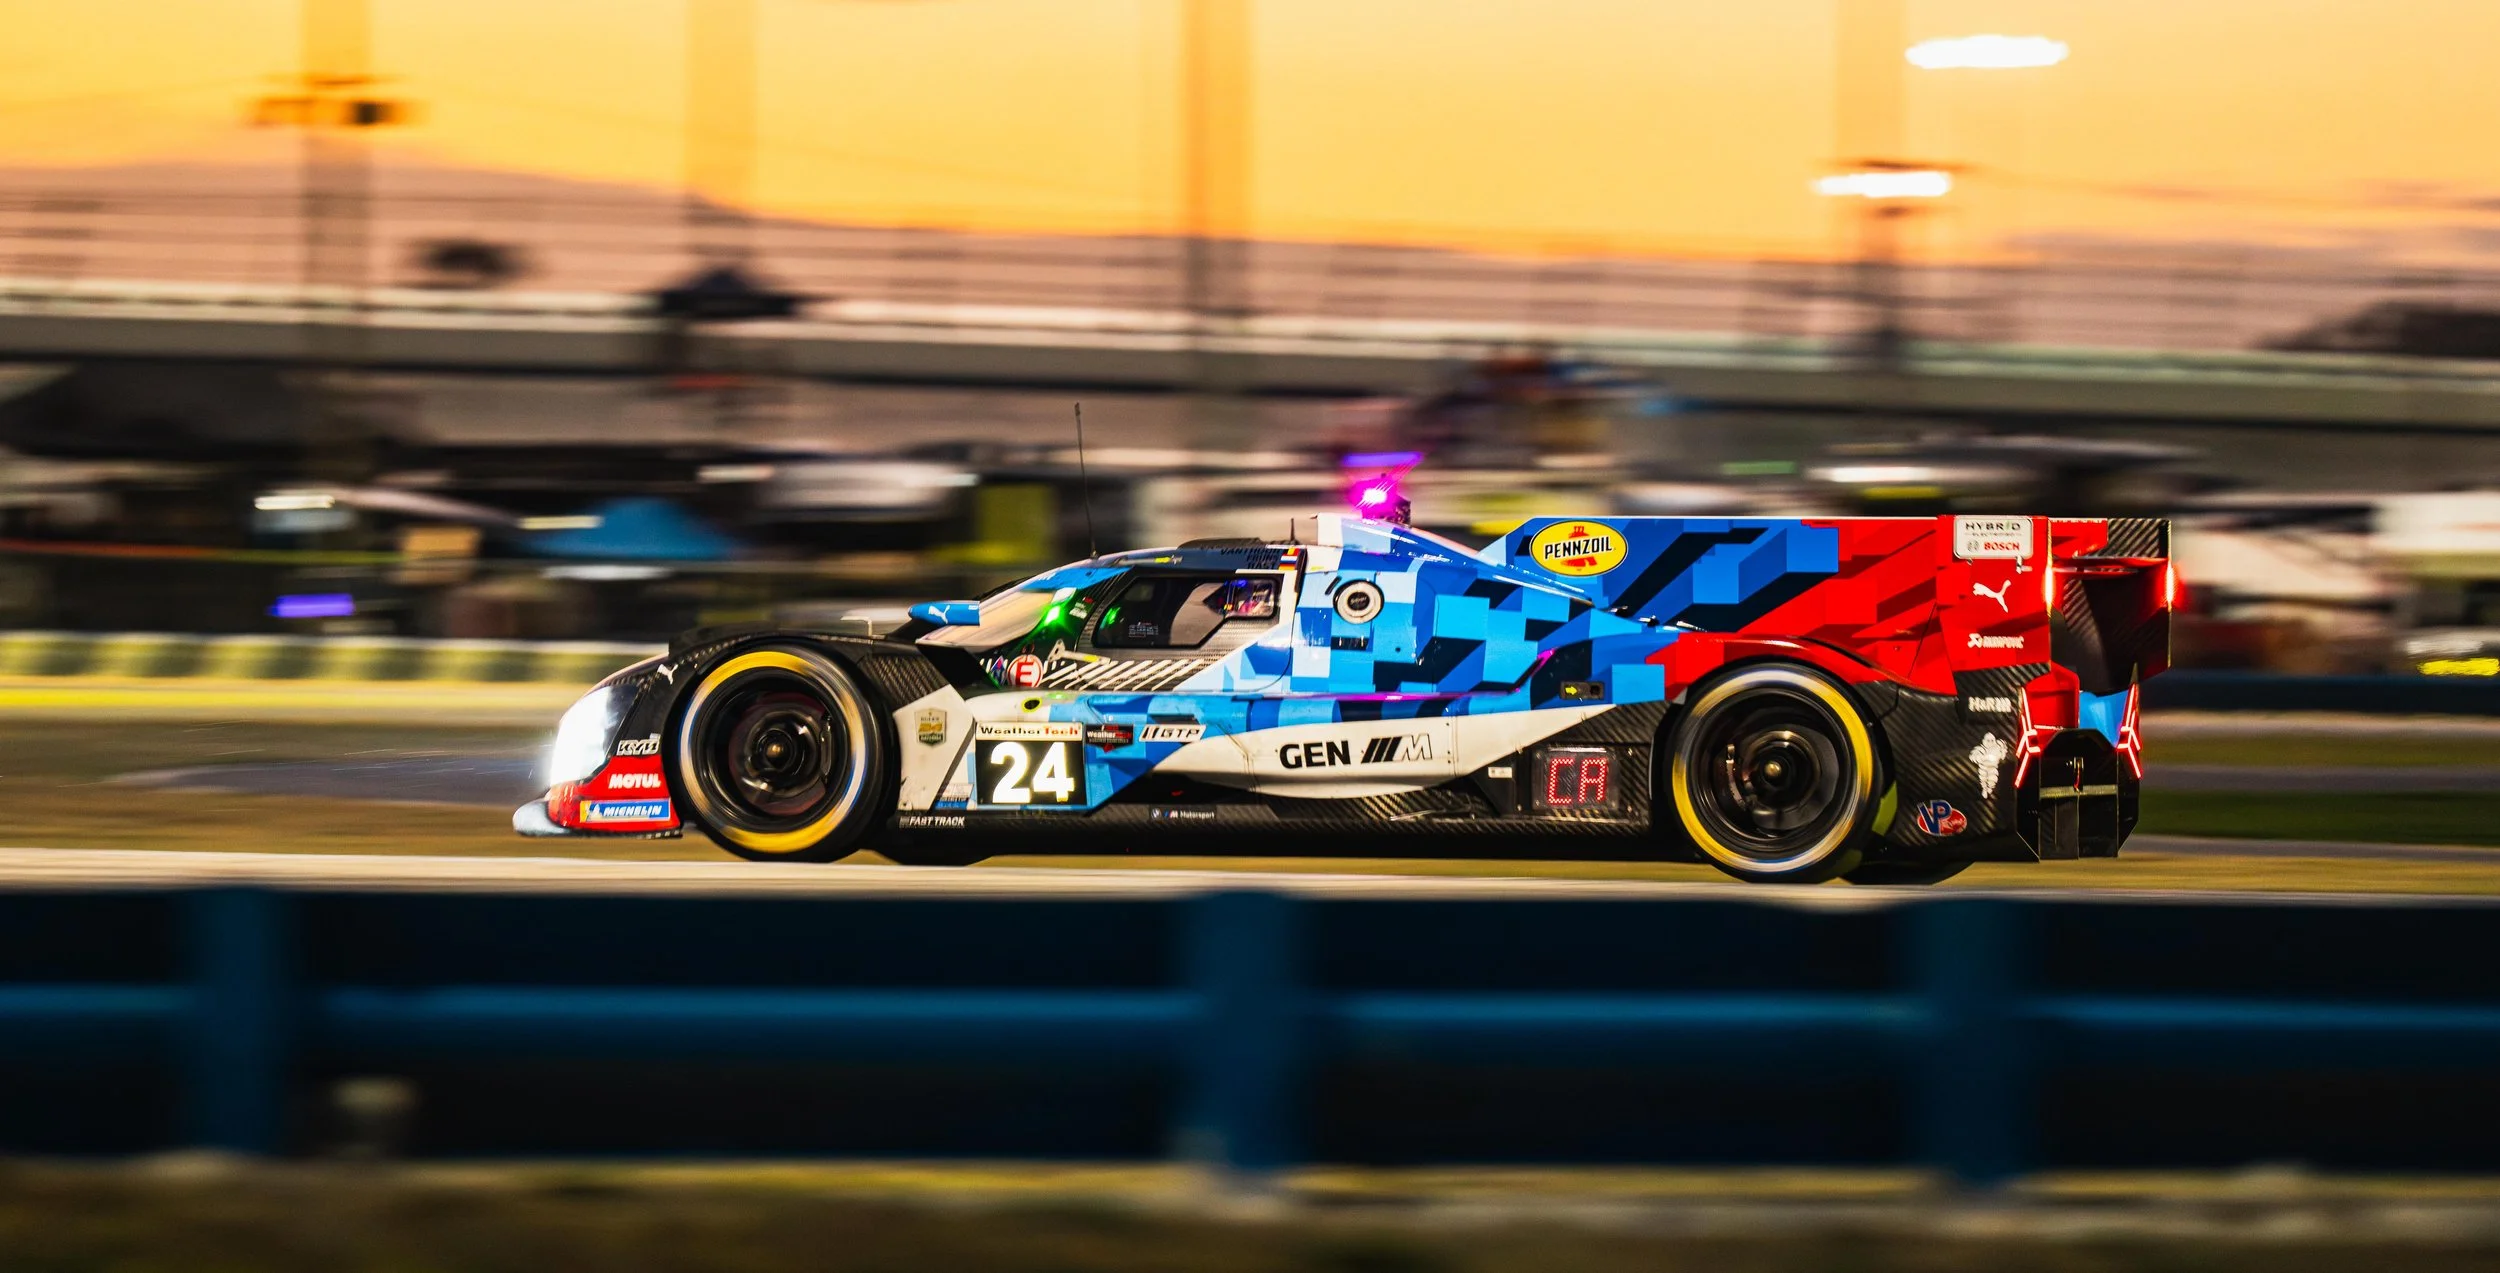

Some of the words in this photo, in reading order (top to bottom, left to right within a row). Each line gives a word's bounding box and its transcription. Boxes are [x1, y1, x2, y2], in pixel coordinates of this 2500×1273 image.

[1965, 521, 2021, 531] HYBRID
[1544, 536, 1612, 560] PENNZOIL
[1983, 541, 2020, 551] BOSCH
[1015, 661, 1034, 688] E
[980, 726, 1079, 737] WeatherTech
[1160, 728, 1200, 739] GTP
[1279, 739, 1352, 770] GEN
[989, 741, 1076, 804] 24
[1547, 757, 1608, 804] CA
[607, 773, 662, 789] MOTUL
[602, 804, 663, 817] MICHELIN
[1917, 800, 1953, 836] VP
[909, 815, 934, 826] FAST
[934, 815, 966, 826] TRACK
